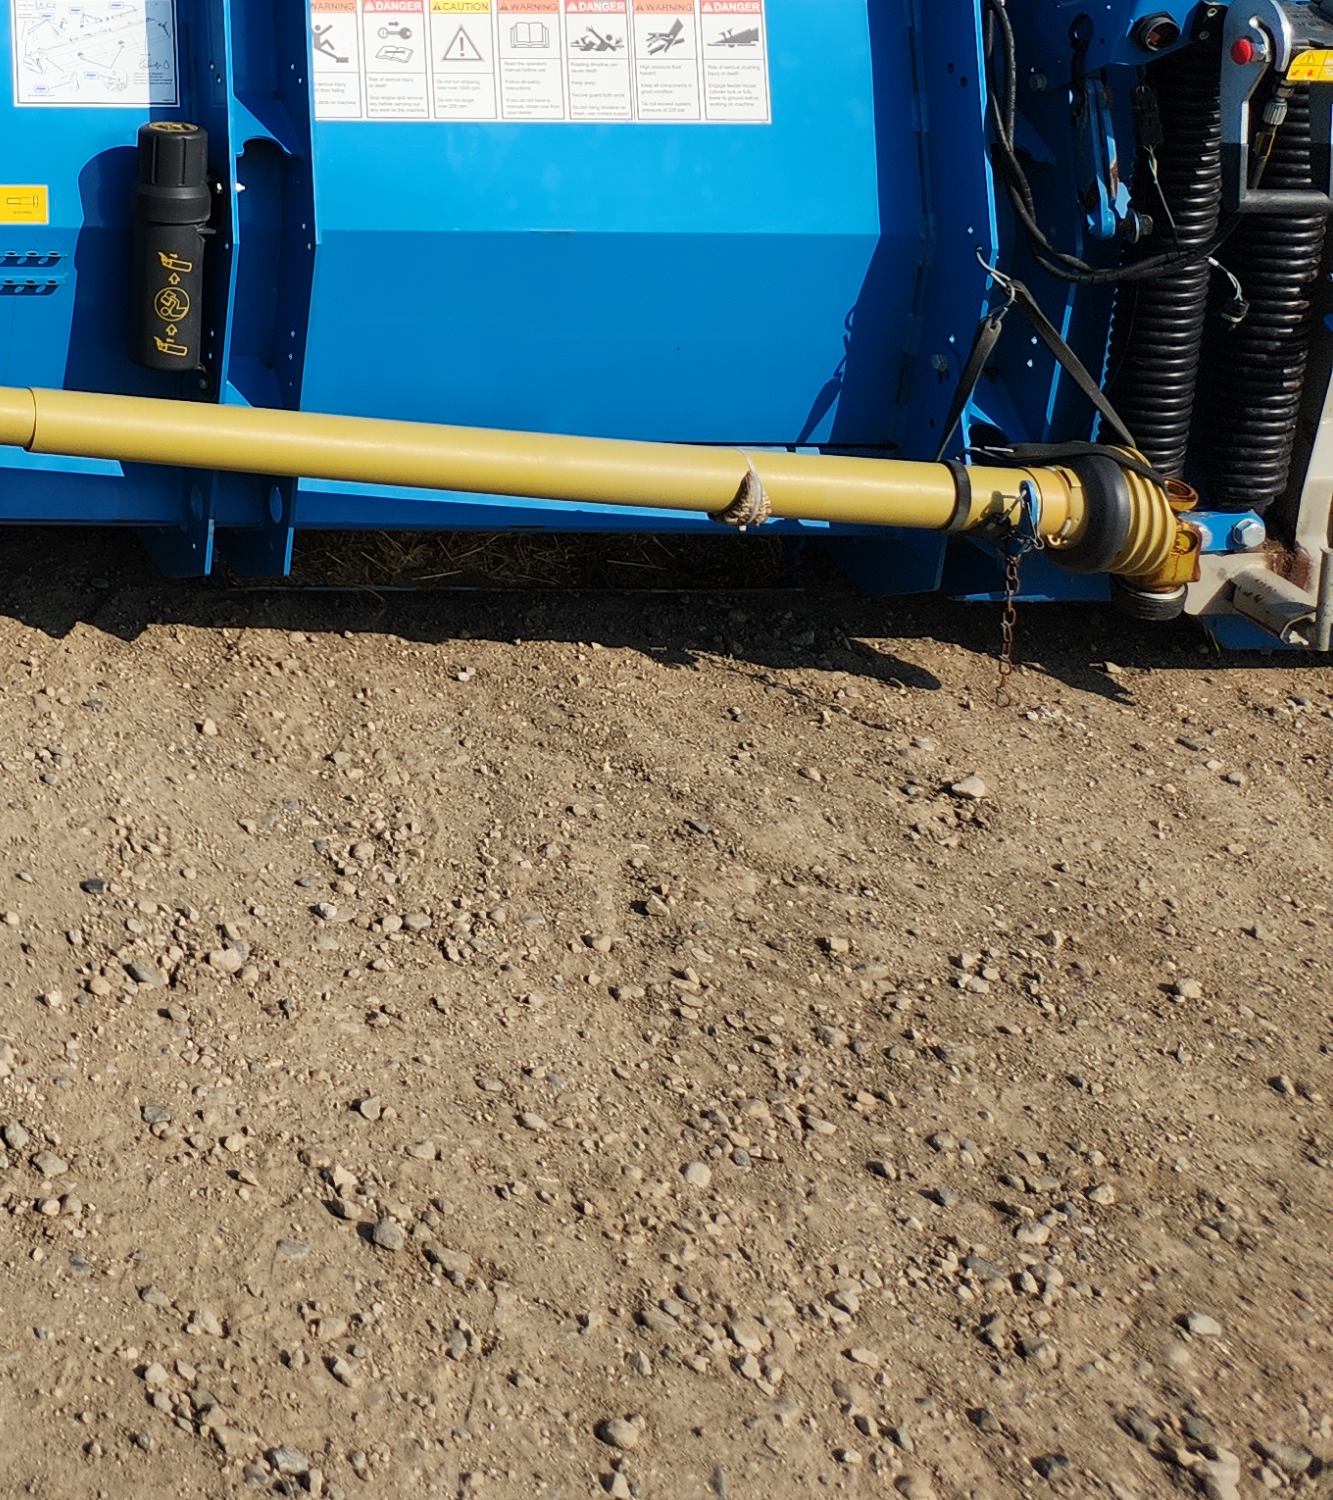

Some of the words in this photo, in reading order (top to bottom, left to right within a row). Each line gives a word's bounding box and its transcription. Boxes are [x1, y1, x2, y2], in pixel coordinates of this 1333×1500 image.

[376, 1, 422, 11] DANGER
[443, 2, 489, 11] CAUTION
[511, 3, 557, 11] WARNING
[578, 2, 624, 11] DANGER
[714, 2, 760, 11] DANGER
